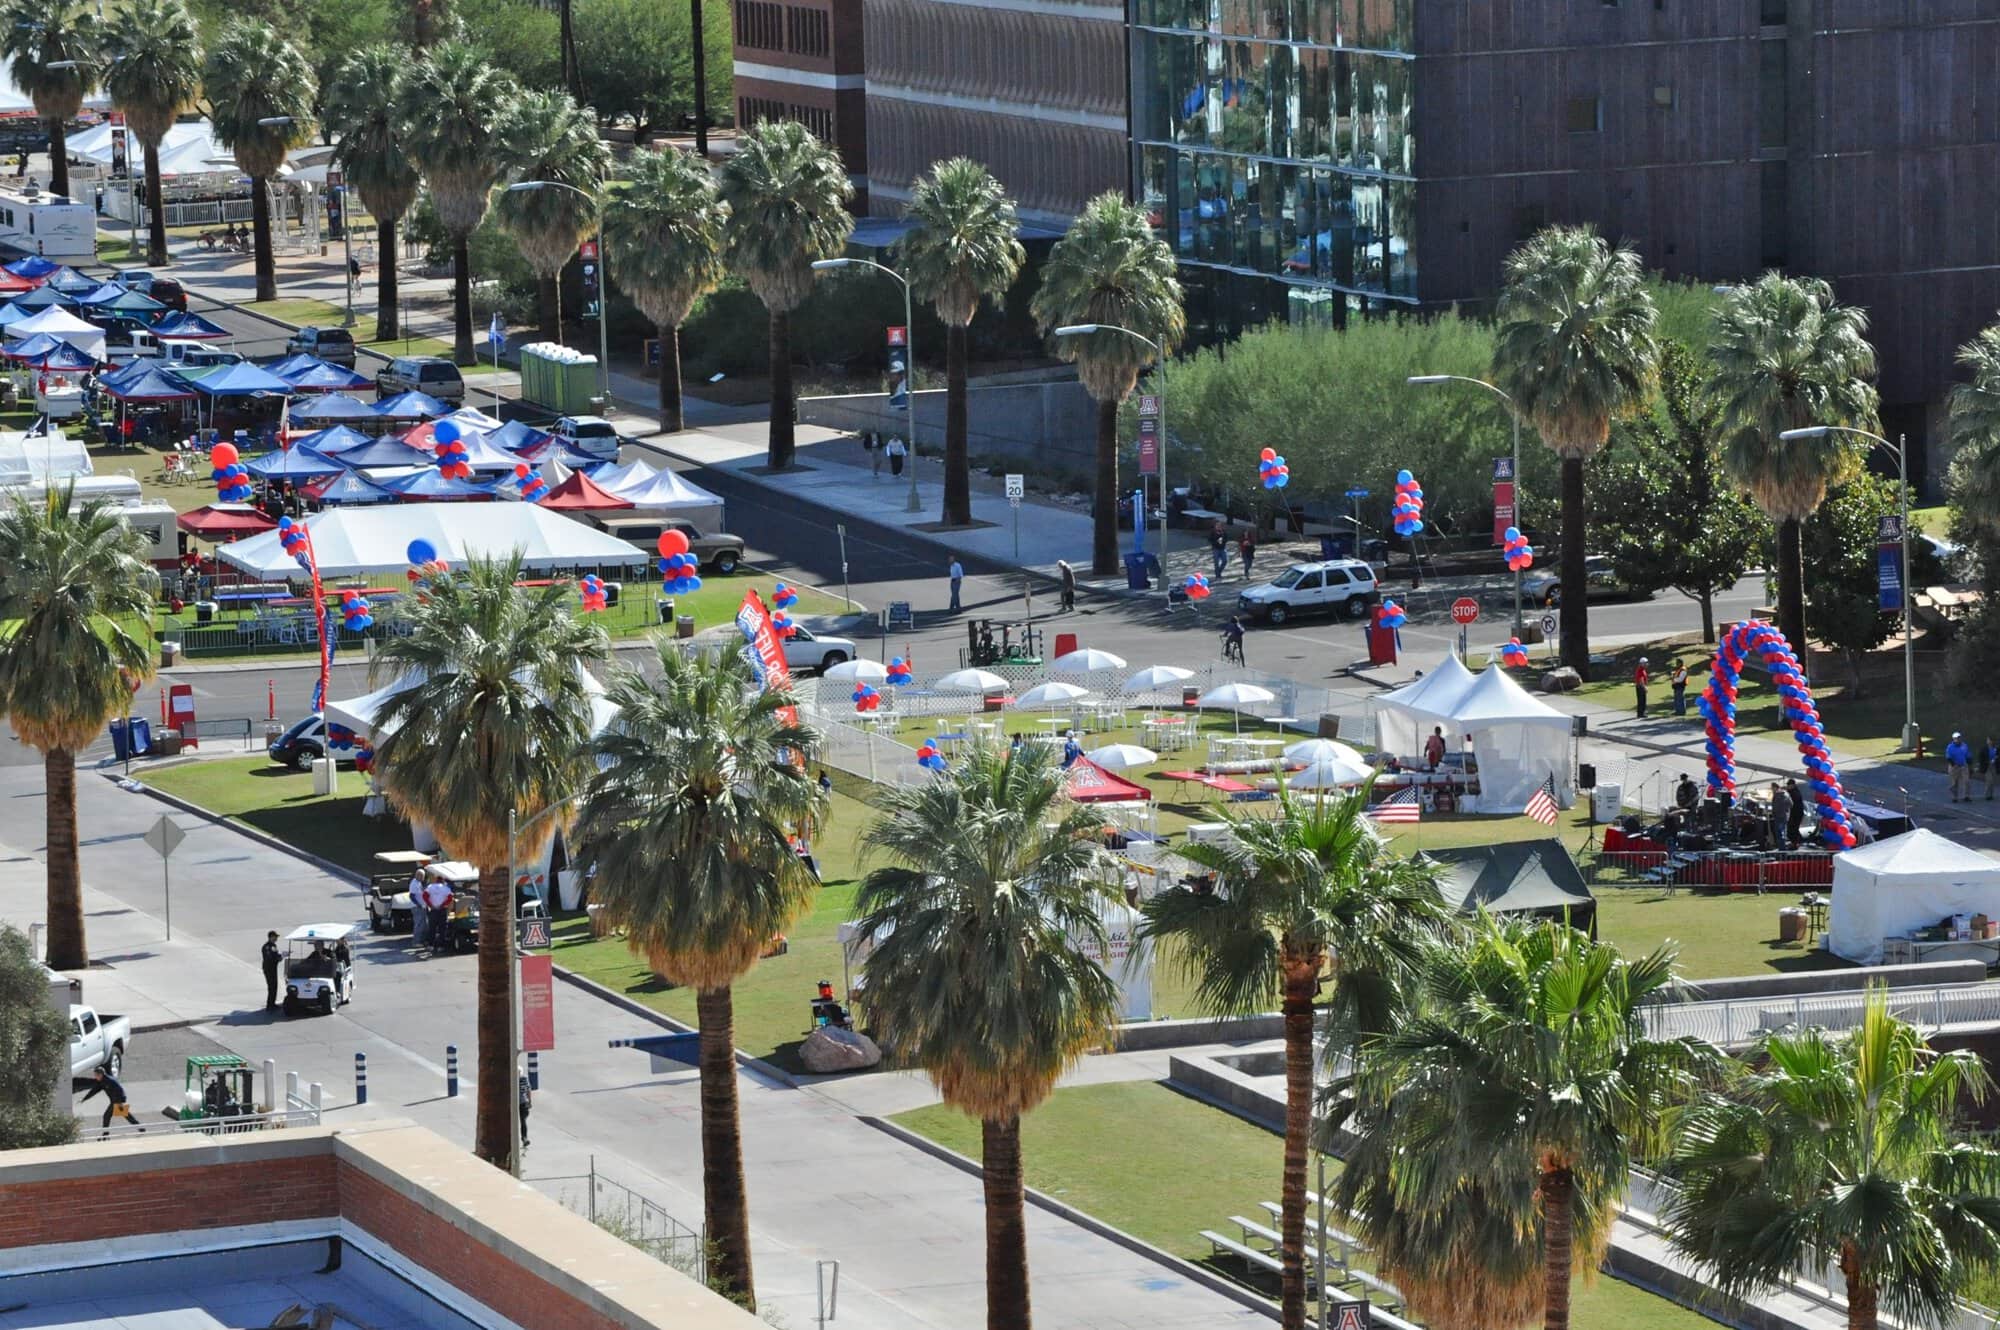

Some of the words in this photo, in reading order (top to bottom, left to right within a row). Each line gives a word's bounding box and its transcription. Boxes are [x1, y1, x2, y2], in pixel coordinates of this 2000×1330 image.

[1008, 486, 1021, 496] 20
[1453, 606, 1477, 617] STOP
[522, 921, 549, 947] A
